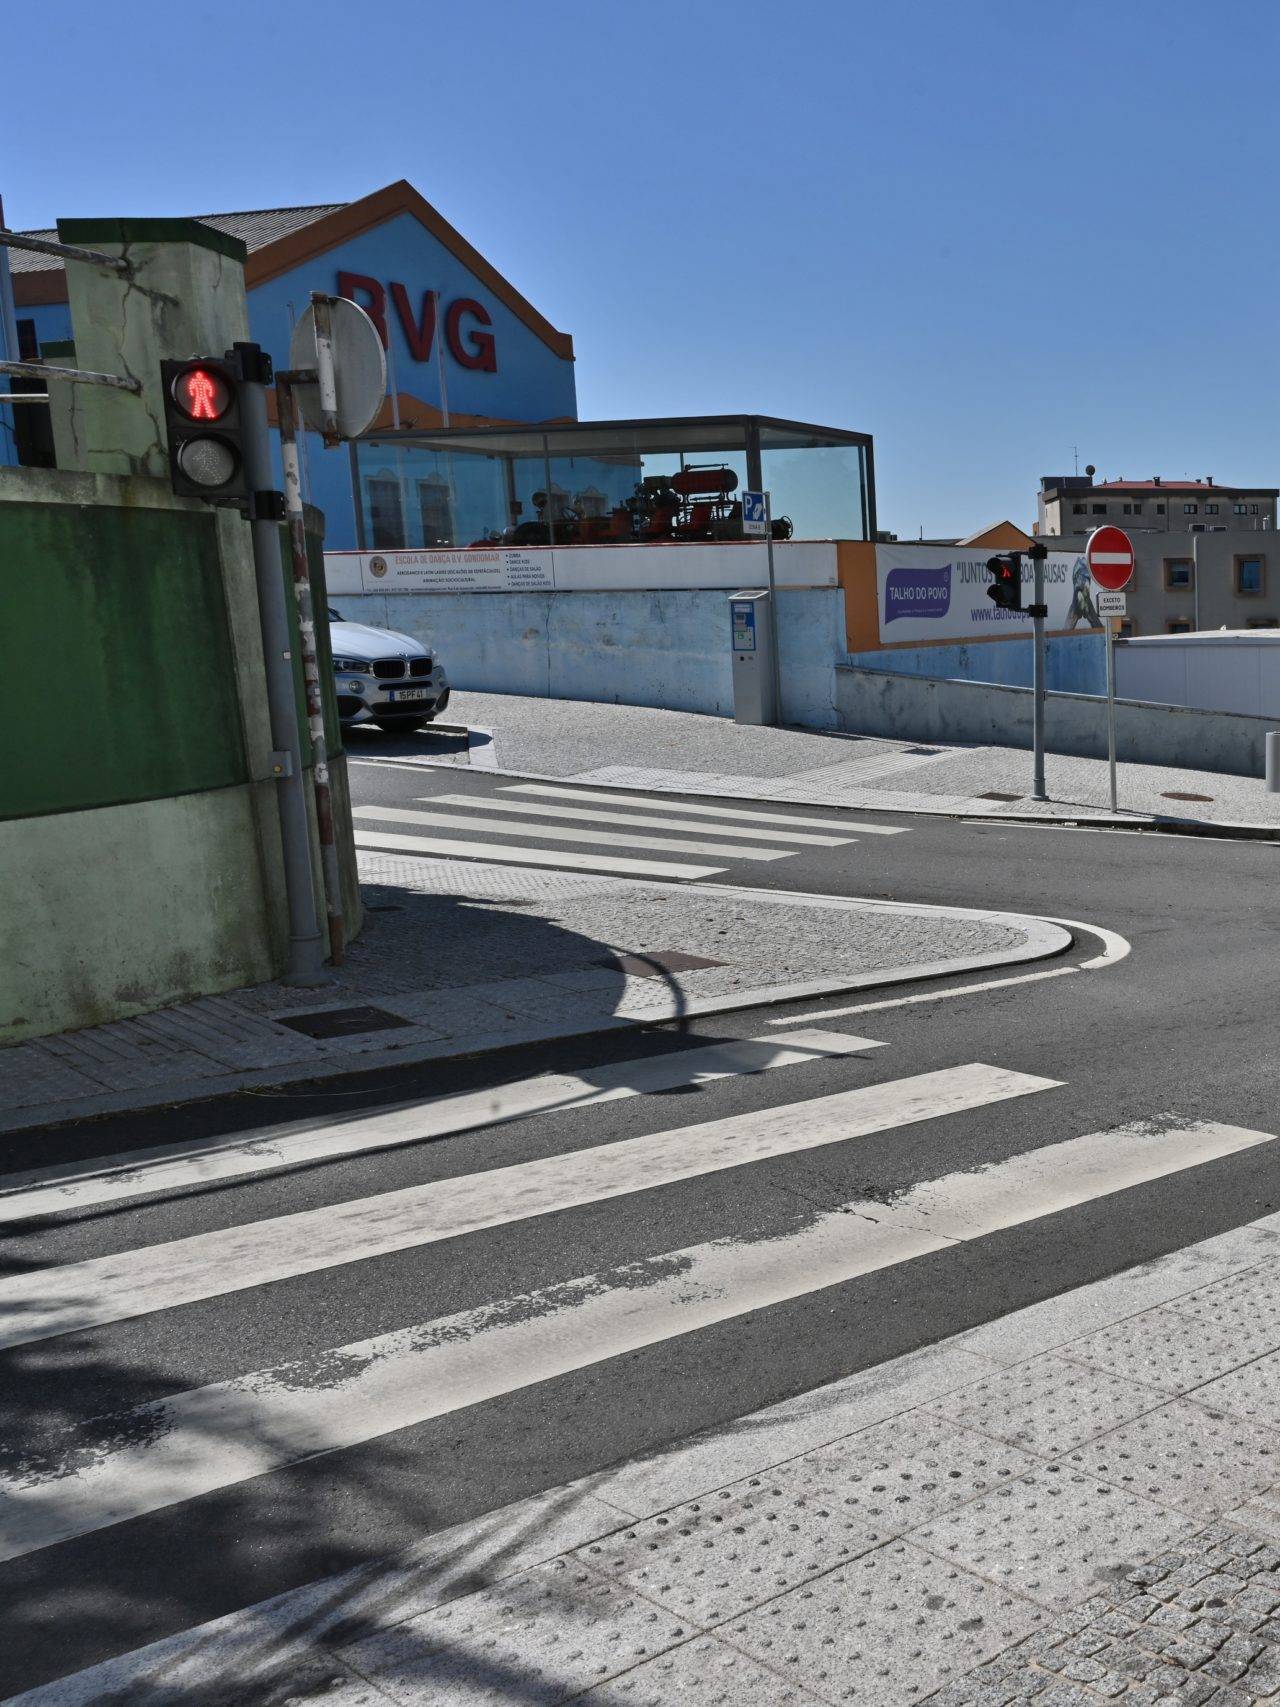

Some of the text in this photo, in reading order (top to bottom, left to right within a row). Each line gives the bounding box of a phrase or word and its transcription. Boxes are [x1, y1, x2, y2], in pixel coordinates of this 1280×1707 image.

[337, 270, 497, 373] BVG
[744, 495, 753, 516] P
[395, 555, 419, 565] ESCOLA
[889, 586, 948, 600] TALHO DO POVO
